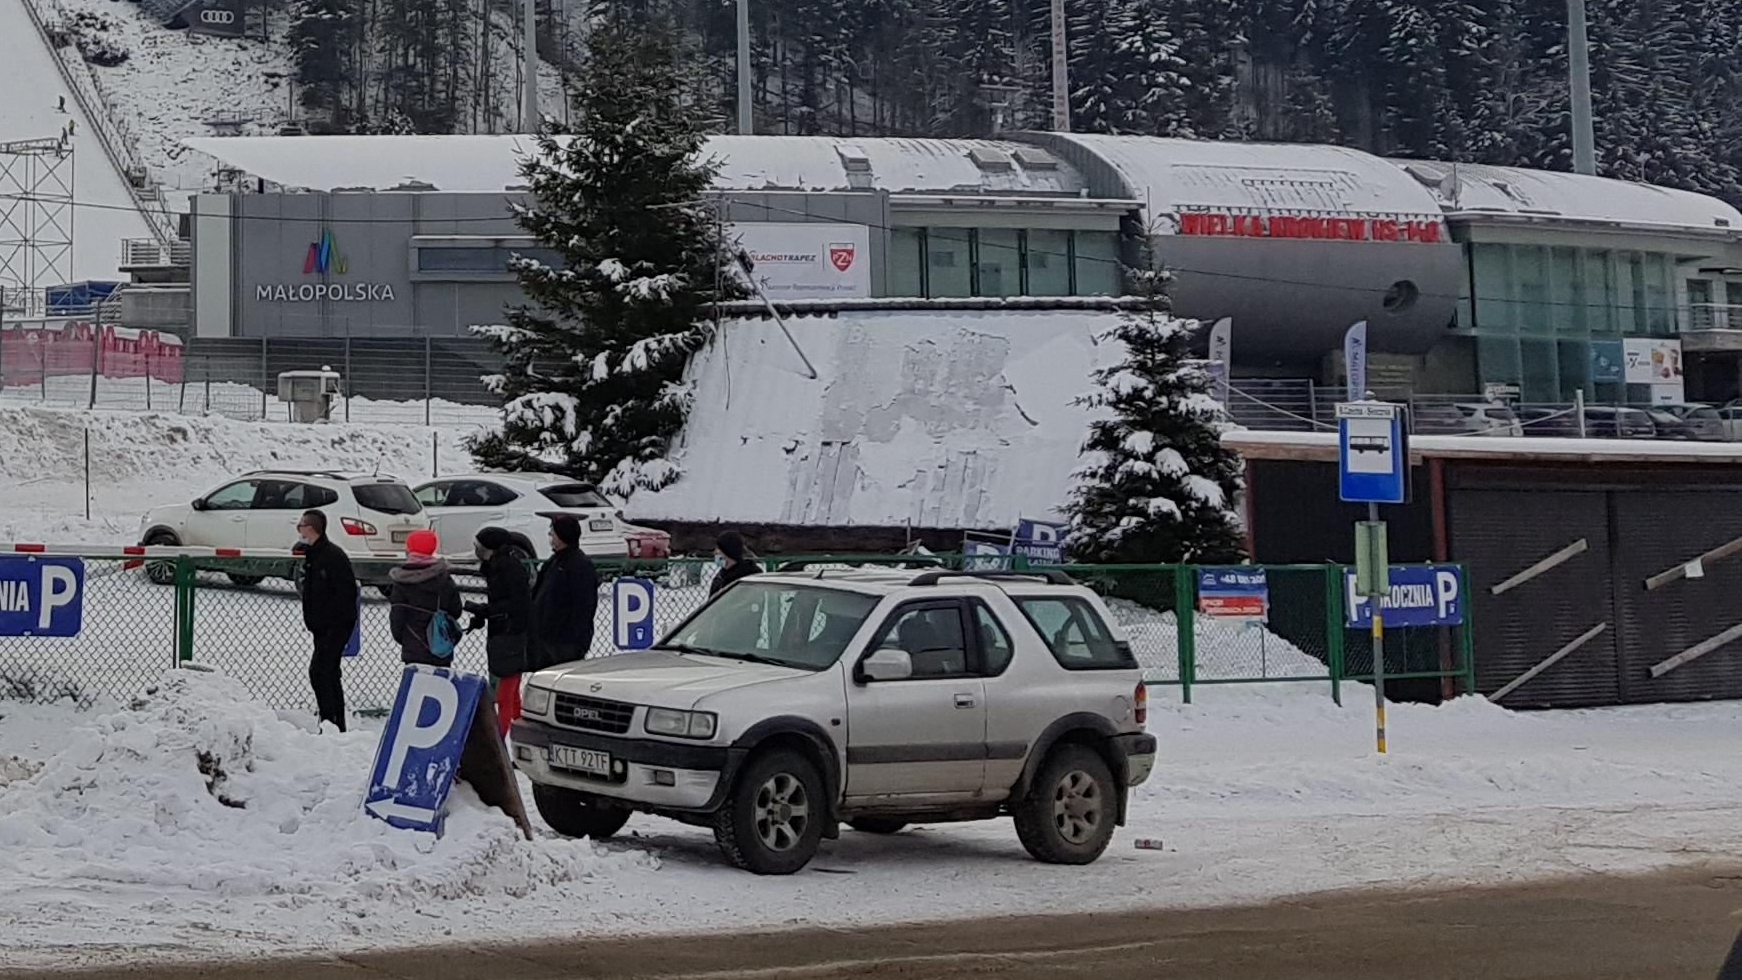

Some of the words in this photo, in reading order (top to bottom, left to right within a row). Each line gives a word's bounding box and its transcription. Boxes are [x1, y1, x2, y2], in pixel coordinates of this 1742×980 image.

[832, 251, 853, 266] PZN
[256, 283, 395, 301] MAŁOPOLSKA
[1016, 545, 1060, 559] PARKING
[38, 565, 77, 628] P
[1436, 572, 1458, 618] P
[617, 583, 650, 646] P
[573, 707, 602, 720] OPEL
[382, 672, 459, 788] P
[580, 751, 608, 771] 92TF
